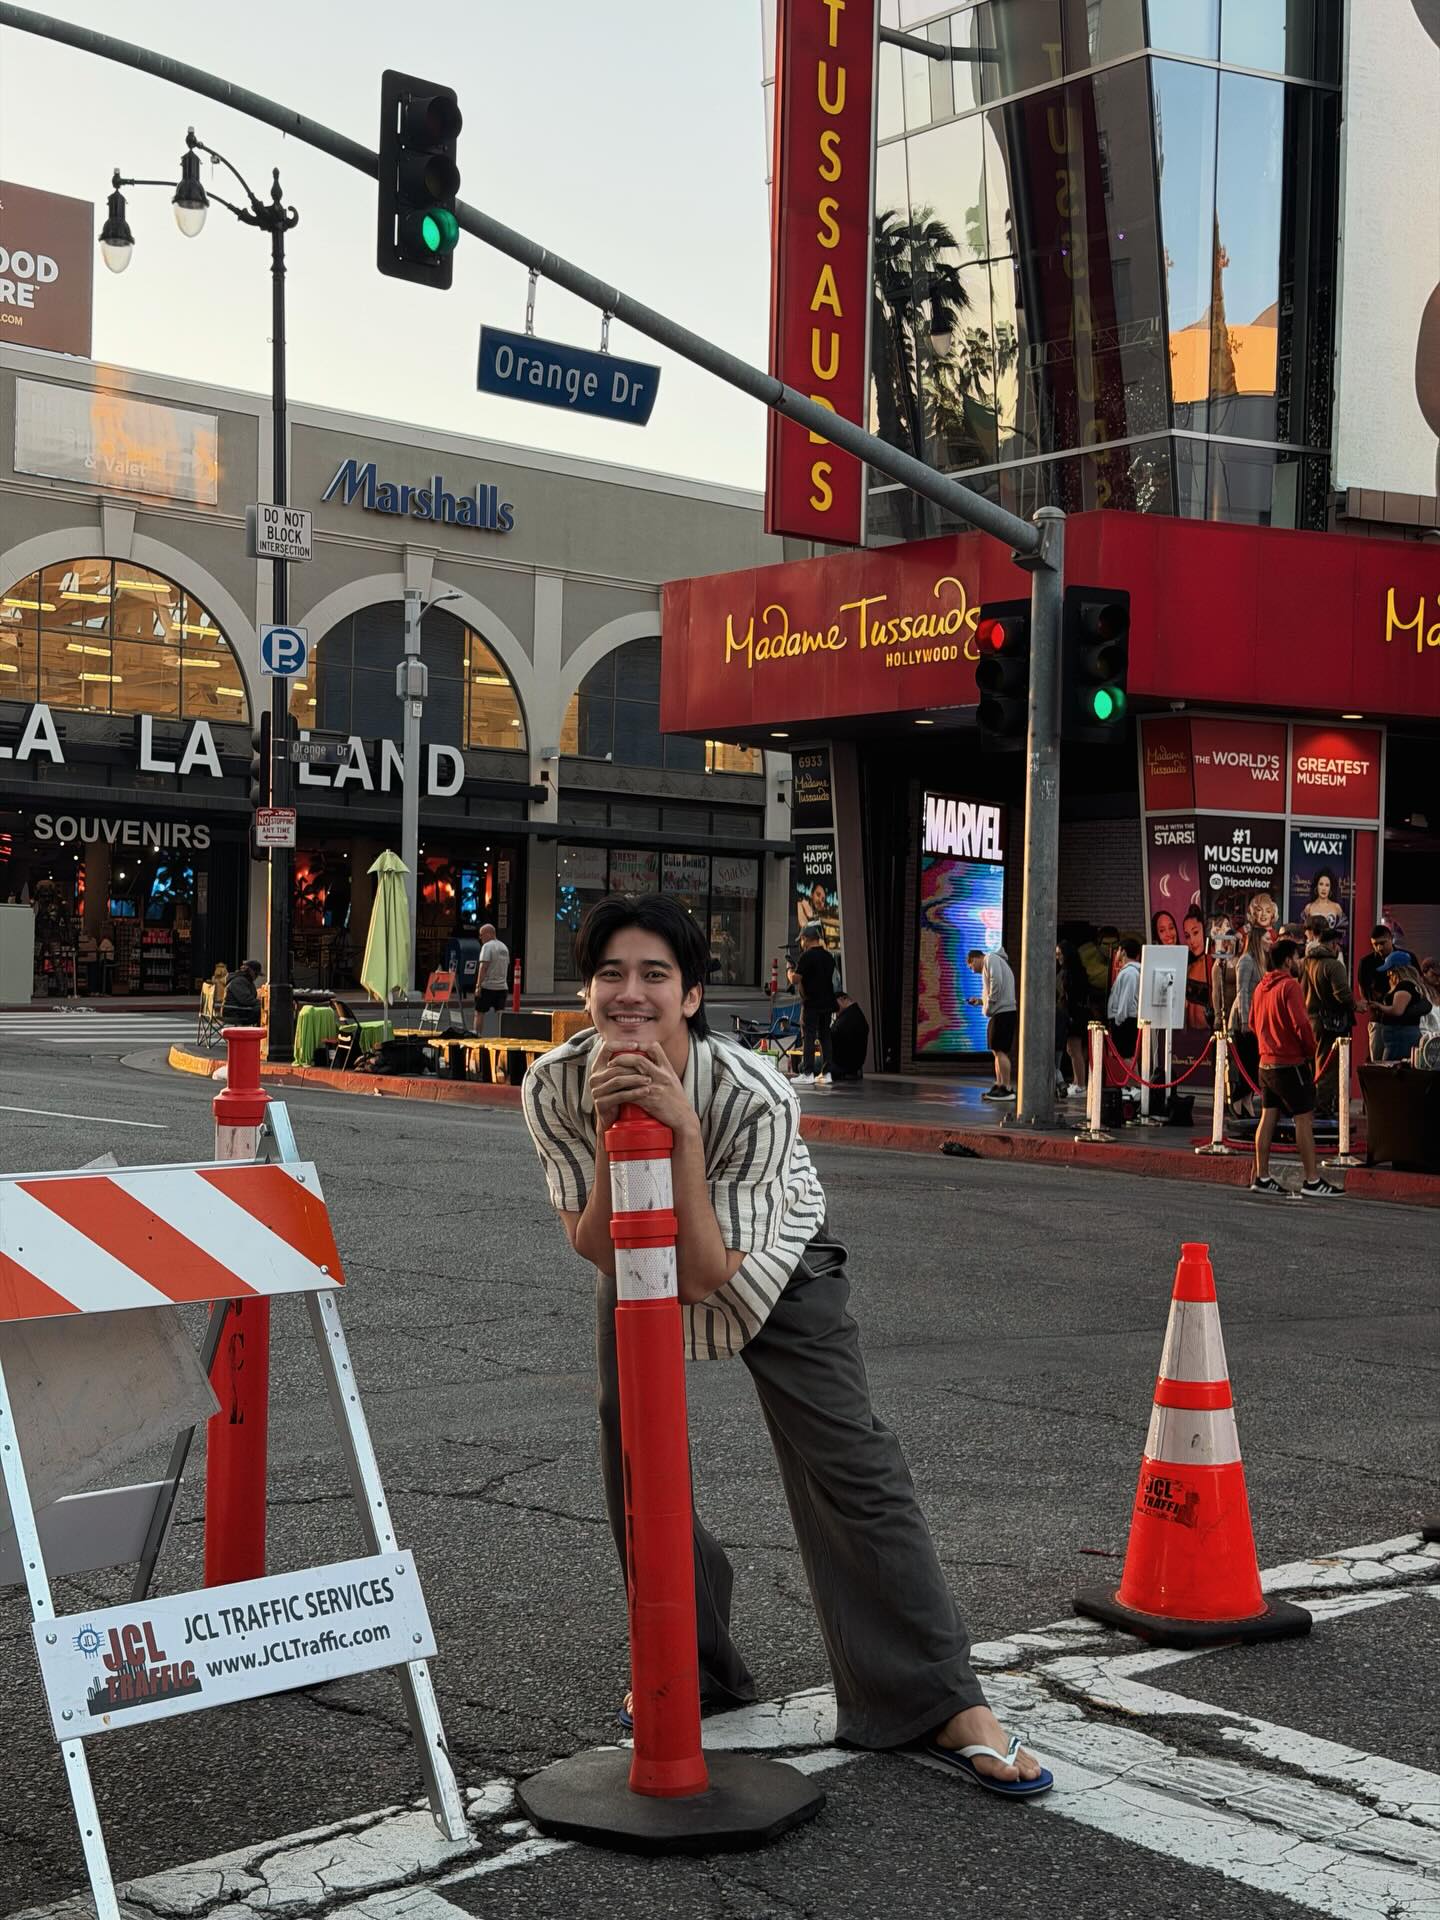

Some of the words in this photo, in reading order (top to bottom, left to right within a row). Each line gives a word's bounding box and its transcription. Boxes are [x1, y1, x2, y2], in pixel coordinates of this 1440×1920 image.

[495, 345, 598, 403] Orange
[611, 370, 644, 407] Dr
[104, 456, 147, 477] Valet
[321, 458, 515, 533] Marshalls
[264, 508, 279, 524] DO
[284, 512, 306, 529] NOT
[267, 526, 302, 544] BLOCK
[259, 540, 311, 557] INTERSECTION
[1386, 587, 1440, 653] Ma
[725, 604, 848, 669] Madame
[886, 645, 958, 667] HOLLYWOOD
[139, 714, 224, 778] LA
[292, 742, 327, 757] Orange
[336, 745, 348, 756] Dr
[1146, 745, 1186, 762] Madame
[799, 756, 823, 768] 6933
[1194, 755, 1210, 764] THE
[1212, 751, 1279, 769] WORLD'S
[1297, 757, 1370, 776] GREATEST
[795, 773, 829, 789] Madame
[1251, 769, 1279, 781] WAX
[1296, 772, 1347, 787] MUSEUM
[258, 815, 270, 825] NO
[926, 796, 1003, 861] MARVEL
[34, 814, 211, 849] SOUVENIRS
[262, 826, 274, 834] ANY
[1154, 831, 1195, 845] STARS!
[1232, 828, 1251, 845] #1
[1299, 832, 1340, 841] IMMORTALIZED
[1204, 845, 1279, 864] MUSEUM
[1303, 840, 1343, 856] WAX!
[803, 852, 834, 863] HAPPY
[805, 864, 832, 875] HOUR
[1208, 864, 1218, 872] IN
[1219, 864, 1273, 875] HOLLYWOOD
[1223, 877, 1271, 889] Tripadvisor
[1145, 1477, 1173, 1499] JCL
[1144, 1494, 1184, 1516] TRAFFI
[184, 1613, 219, 1644] JCL
[223, 1594, 304, 1636] TRAFFIC
[304, 1577, 395, 1619] SERVICES
[102, 1621, 167, 1672] JCL
[206, 1622, 391, 1678] www.JCLTraffic.com
[105, 1660, 196, 1704] TRAFFIC
